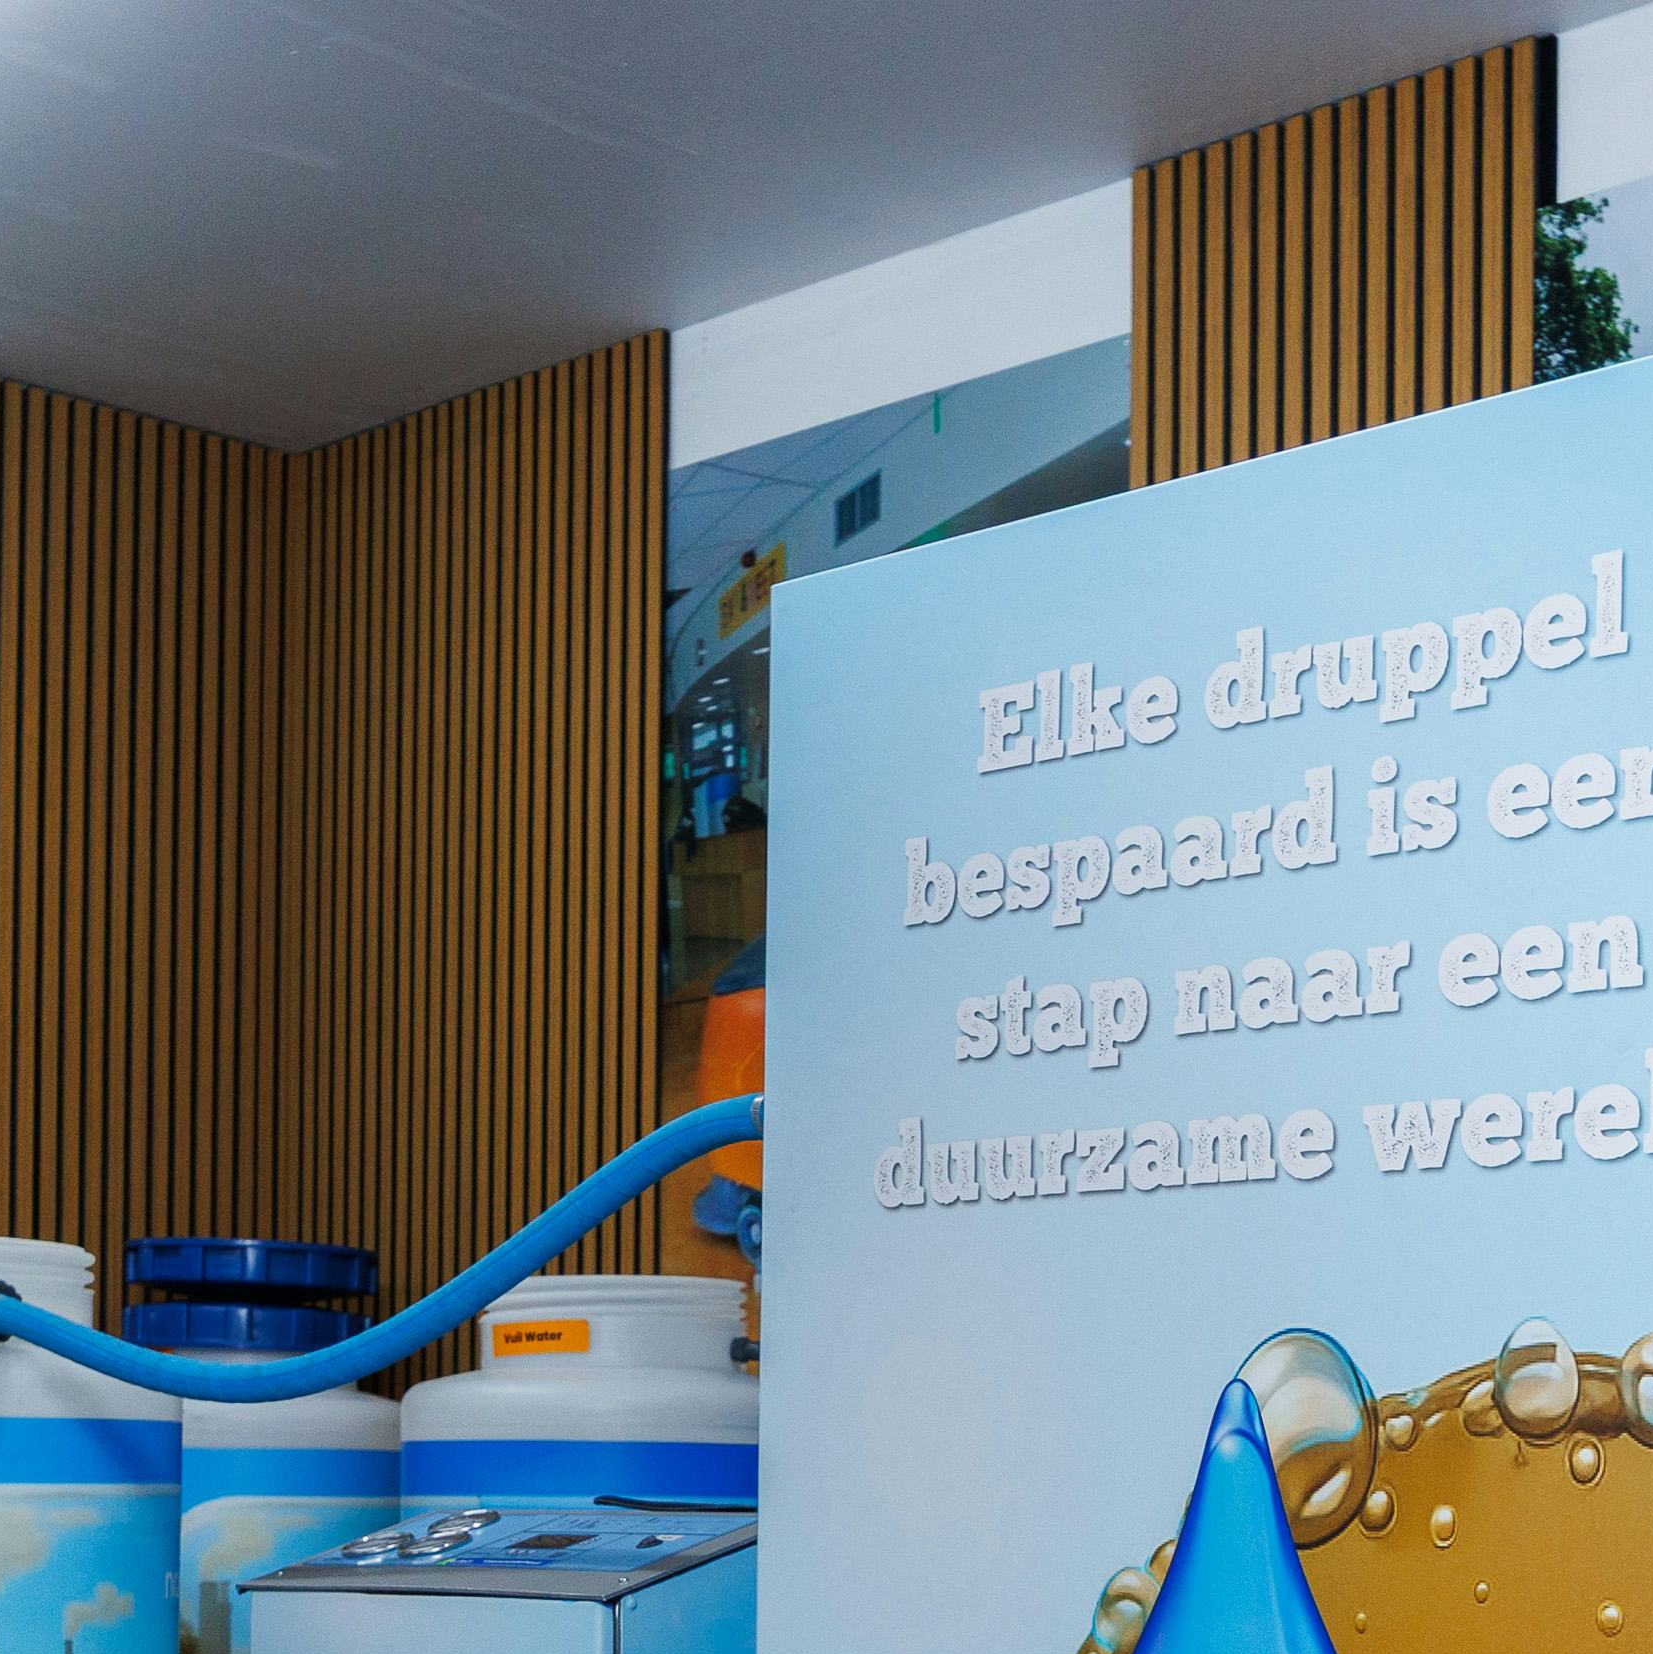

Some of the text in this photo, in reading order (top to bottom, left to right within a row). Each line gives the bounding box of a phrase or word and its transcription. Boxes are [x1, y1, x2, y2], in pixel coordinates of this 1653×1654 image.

[978, 549, 1630, 774] Elke druppel
[903, 764, 1338, 928] bespaard
[1366, 755, 1459, 857] is
[955, 914, 1645, 1069] stap naar een
[873, 1108, 1335, 1208] duurzame
[525, 1330, 562, 1342] Water
